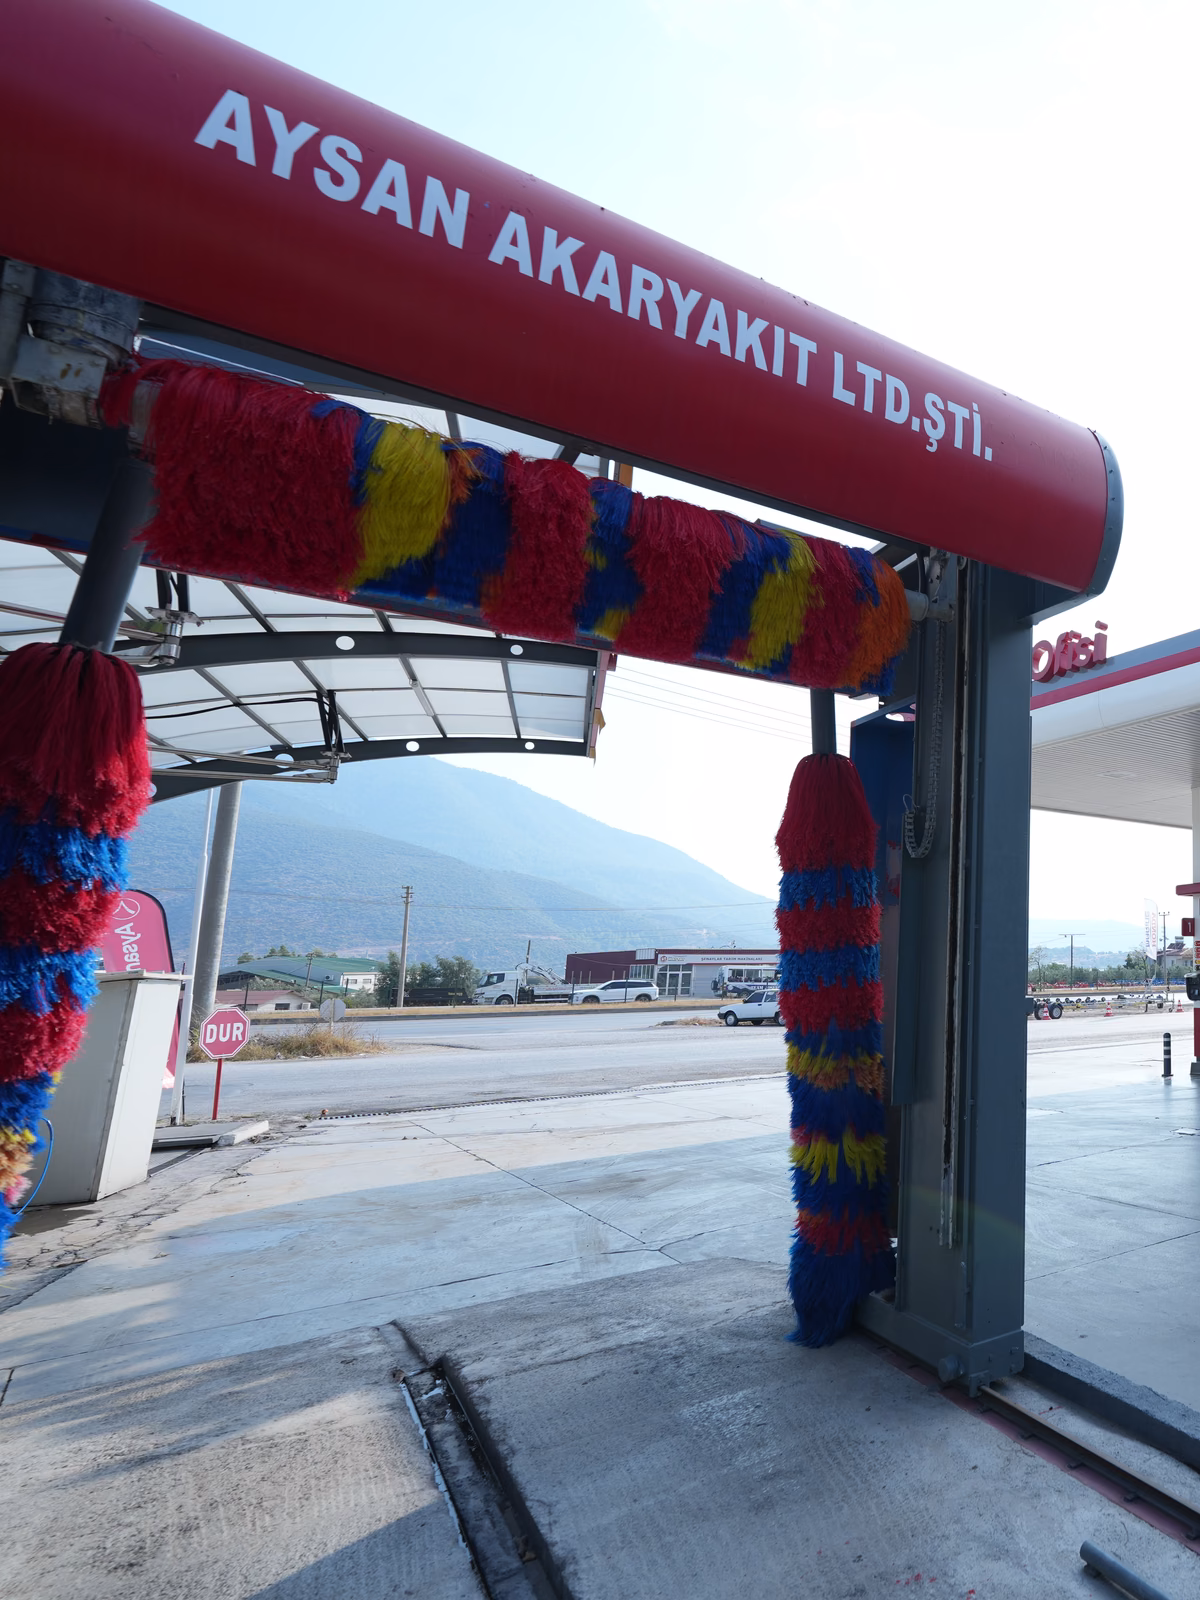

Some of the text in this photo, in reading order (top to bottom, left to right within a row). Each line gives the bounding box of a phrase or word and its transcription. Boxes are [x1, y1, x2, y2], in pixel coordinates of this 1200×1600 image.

[195, 90, 993, 462] AYSAN AKARYAKIT LTD.ŞTİ.
[1032, 620, 1109, 683] Ofisi
[1187, 921, 1192, 933] 1
[205, 1022, 244, 1044] DUR
